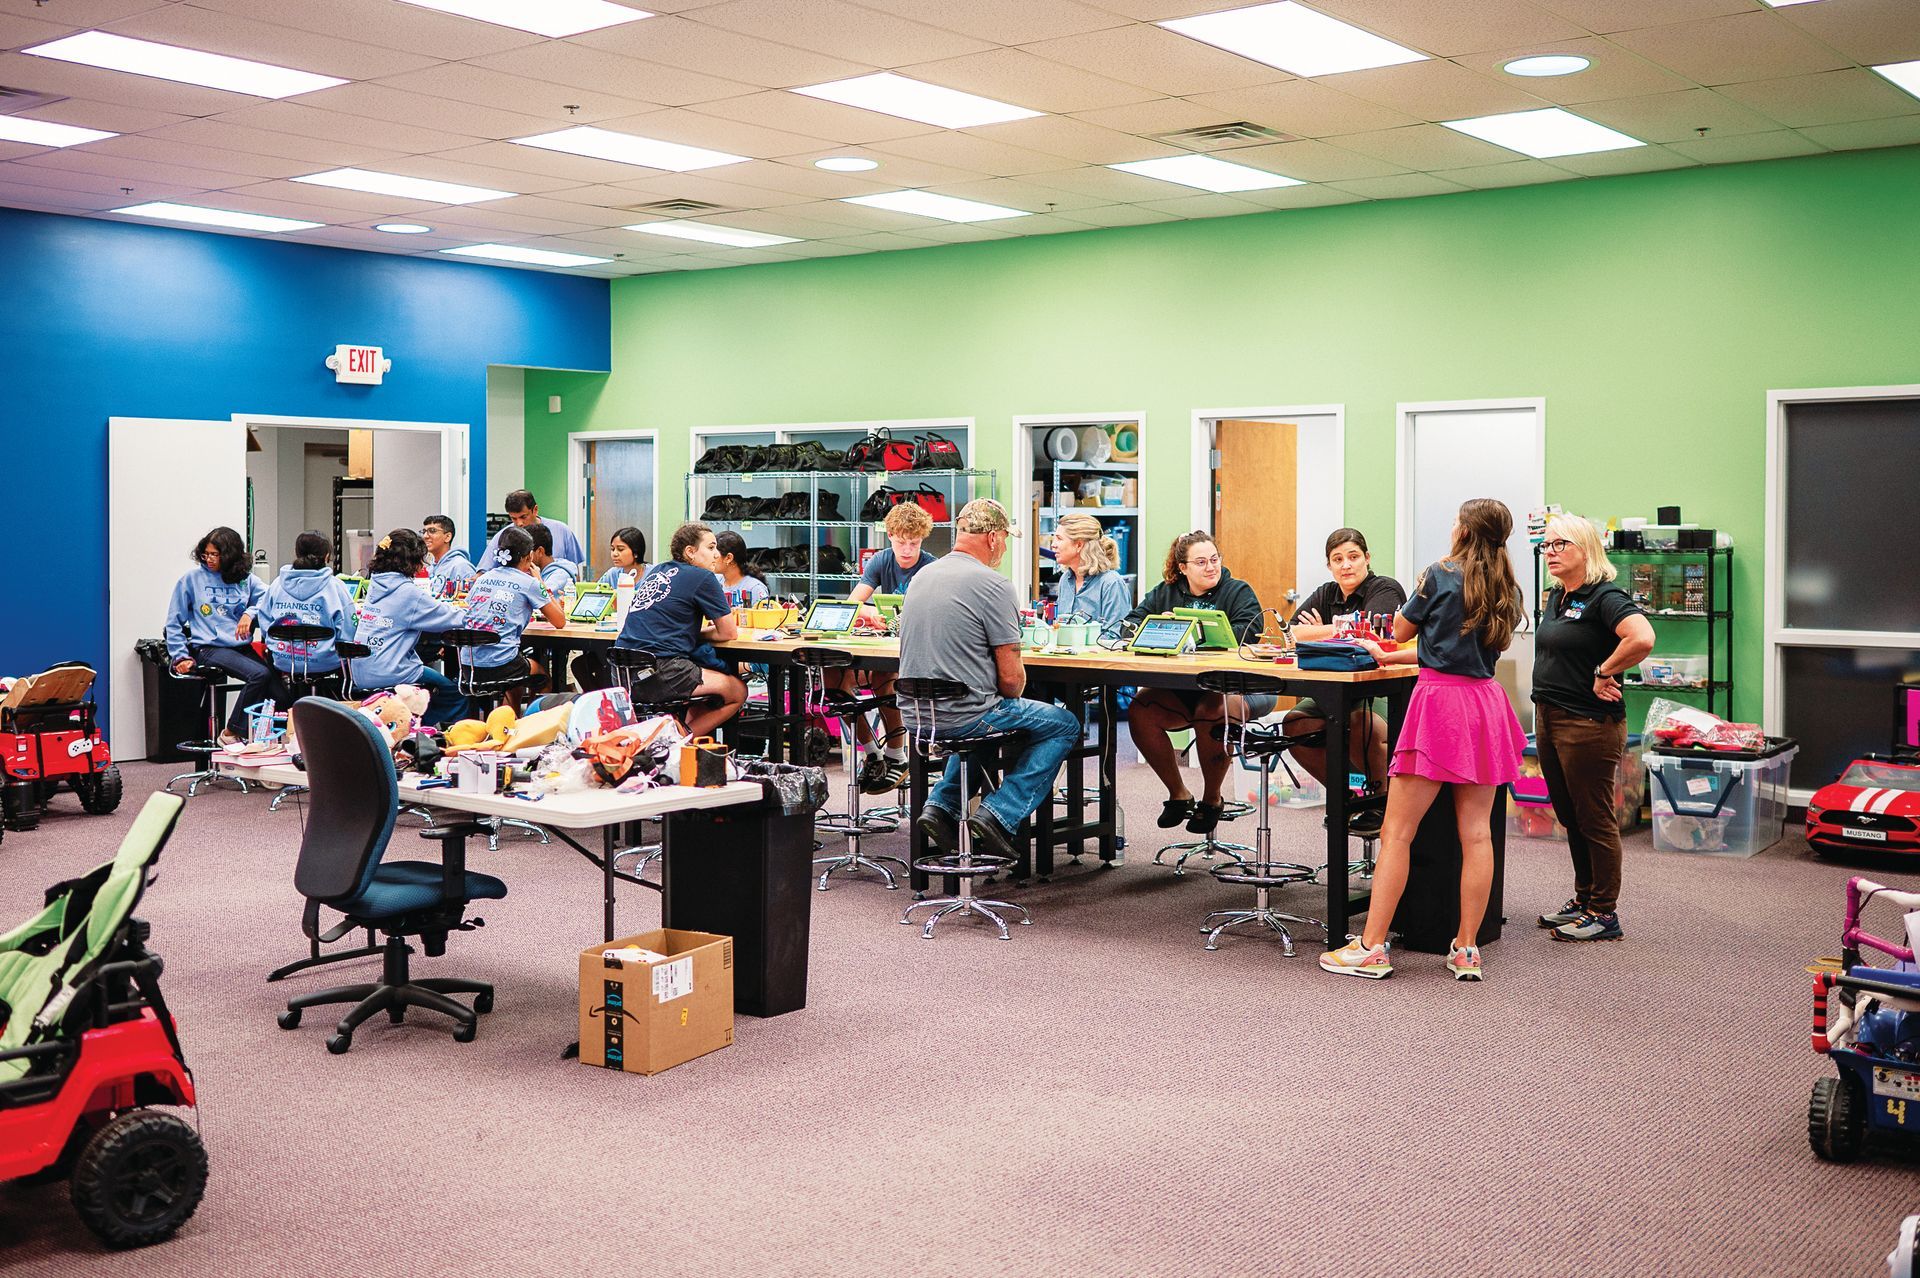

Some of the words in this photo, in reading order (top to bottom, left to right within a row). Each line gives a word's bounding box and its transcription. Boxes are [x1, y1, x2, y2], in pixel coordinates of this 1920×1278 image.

[349, 348, 376, 373] EXIT
[480, 578, 507, 587] ANKS
[655, 585, 671, 602] COAST
[275, 602, 309, 611] THANKS
[488, 600, 508, 613] KSS
[366, 636, 385, 647] KSS
[1846, 829, 1882, 839] MUSTANG
[1887, 1098, 1906, 1125] 4
